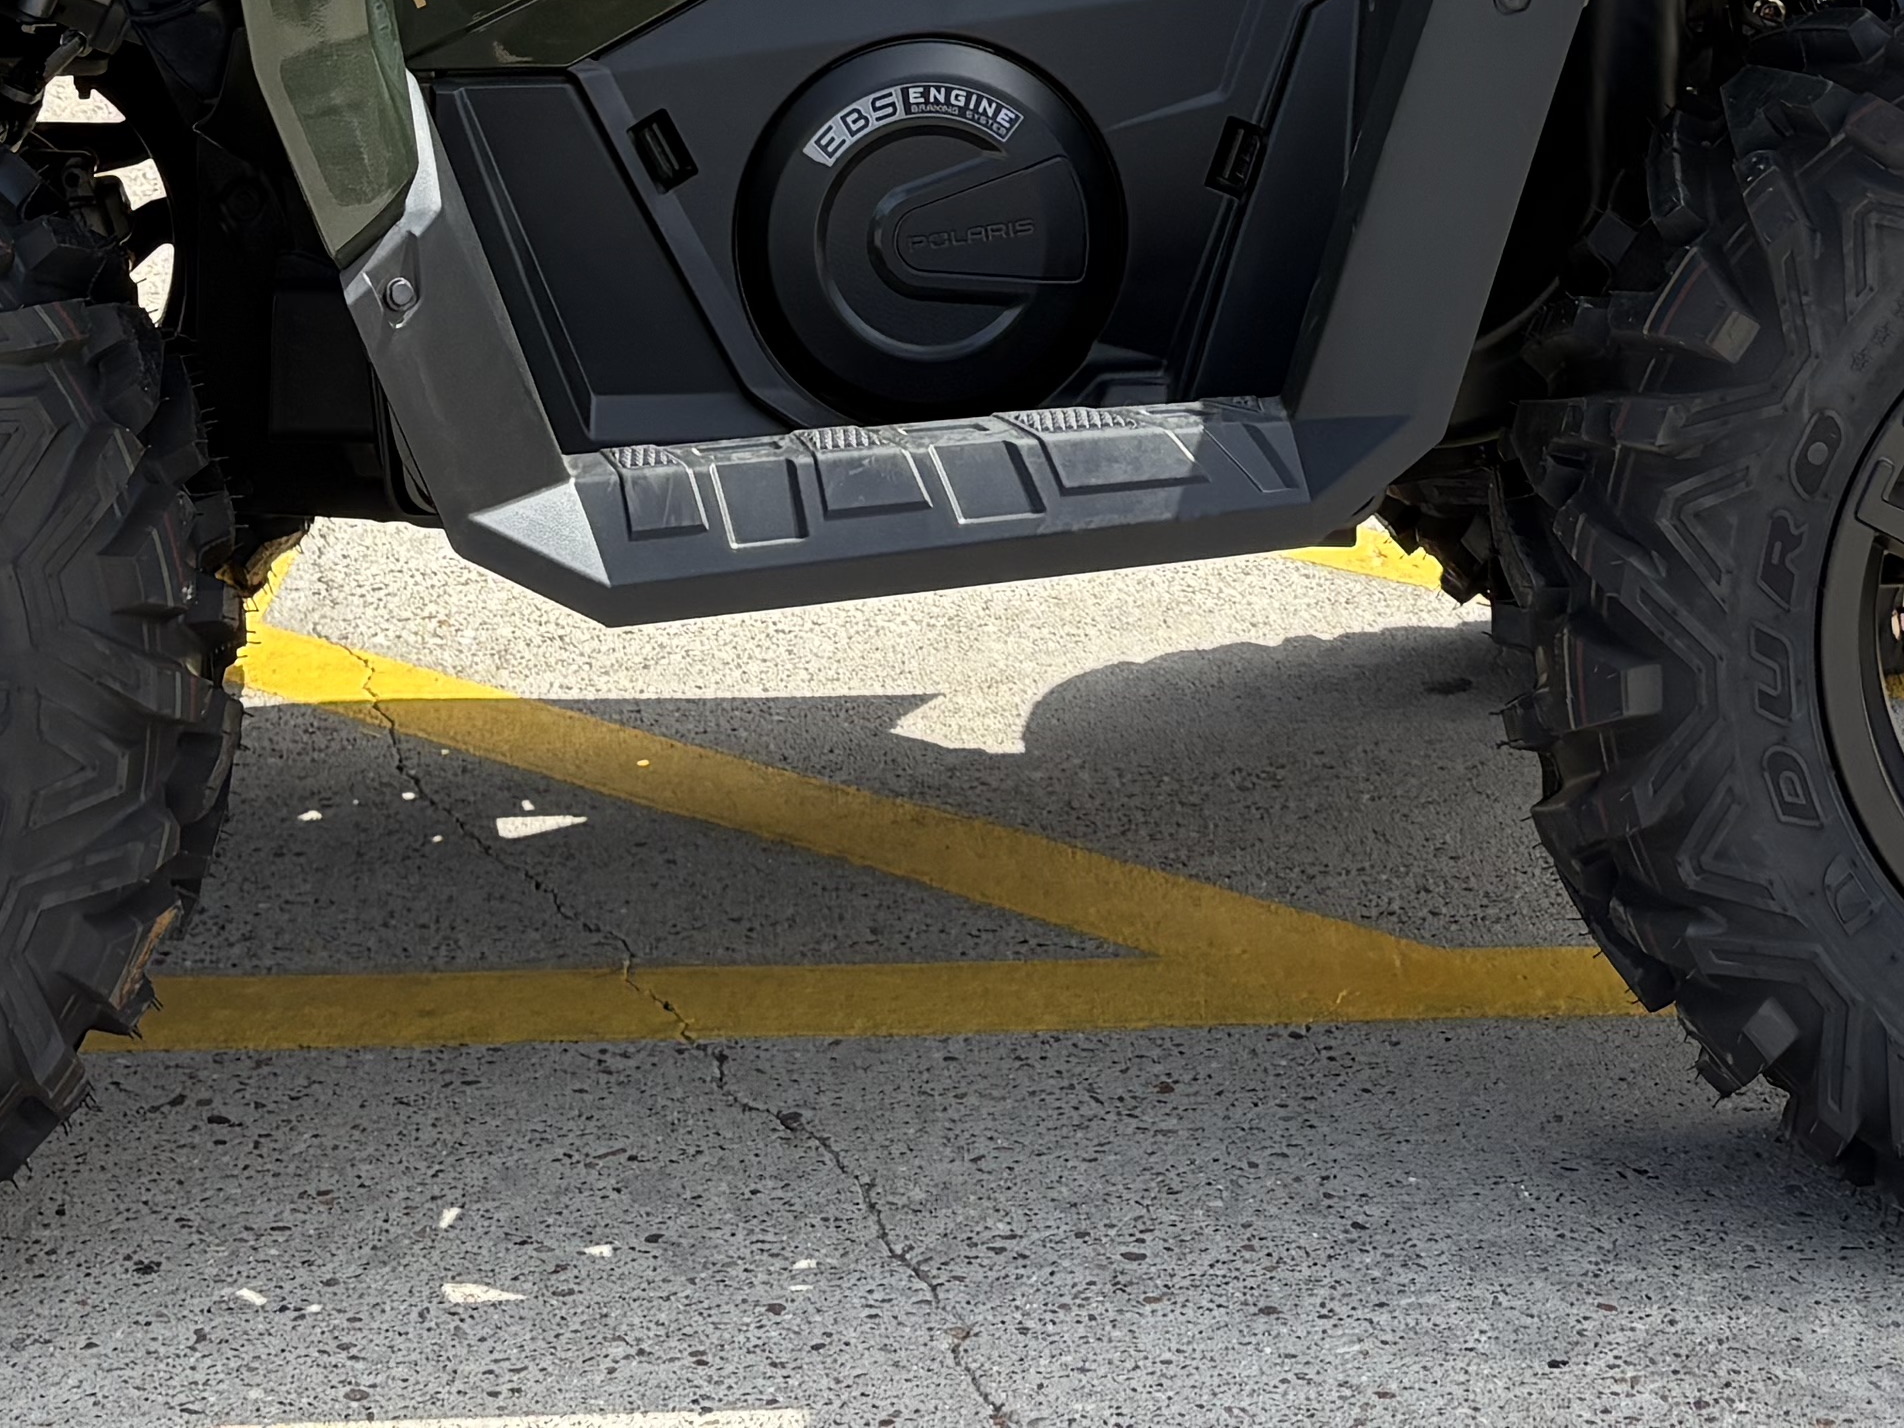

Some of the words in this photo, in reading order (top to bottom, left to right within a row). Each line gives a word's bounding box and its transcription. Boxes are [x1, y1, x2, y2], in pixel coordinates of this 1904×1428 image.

[813, 90, 899, 160] EBS
[908, 87, 1017, 130] ENGINE
[910, 104, 959, 116] BRAKING
[965, 110, 1008, 136] SYSTEM
[908, 219, 1036, 253] POLARIS
[1745, 406, 1847, 833] DURO
